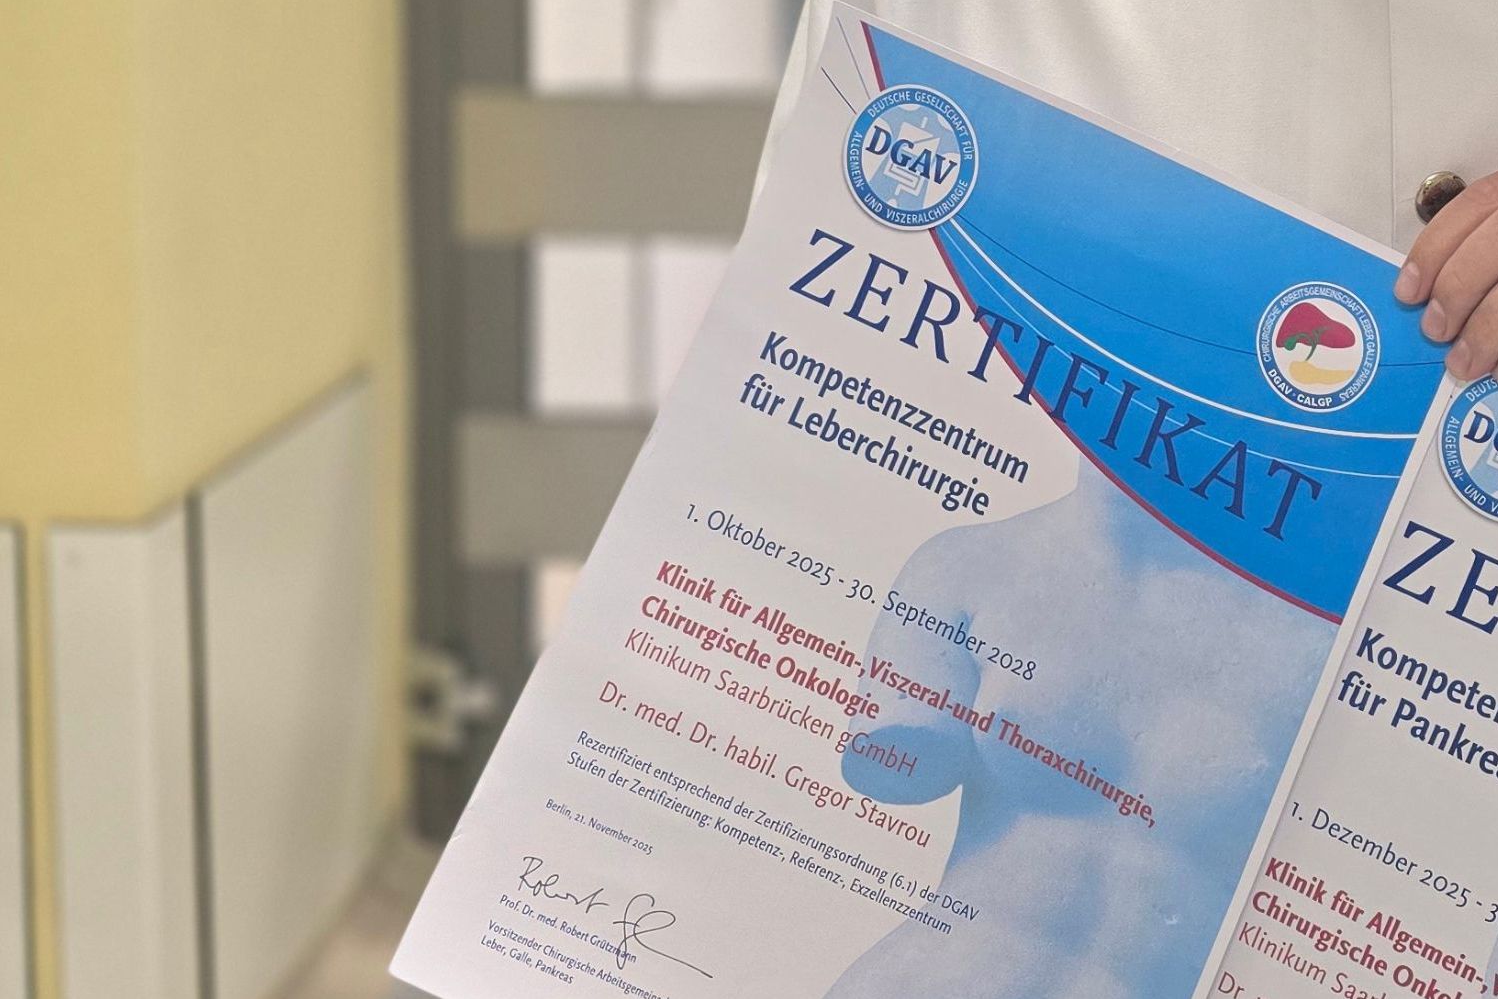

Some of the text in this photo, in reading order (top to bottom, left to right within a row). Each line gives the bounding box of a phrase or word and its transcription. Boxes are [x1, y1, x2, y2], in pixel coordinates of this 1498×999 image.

[865, 125, 958, 185] DGAV
[868, 90, 975, 161] DEUTSCHE GESELLSCHAFT FÜR
[864, 193, 883, 214] UND
[886, 179, 969, 225] VISZERALCHIRURGIE
[760, 331, 1028, 483] Kompetenzzentrum
[790, 229, 1322, 541] ZERTIFIKAT
[1268, 369, 1333, 407] DGAV CALGP
[740, 374, 989, 515] für Leberchirurgie
[1464, 484, 1487, 506] UND
[687, 504, 698, 522] 1.
[708, 511, 785, 558] Oktober
[787, 551, 834, 585] 2025
[846, 579, 875, 604] 30.
[883, 591, 986, 653] September
[987, 647, 1036, 680] 2028
[642, 596, 879, 719] Chirurgische Onkologie
[657, 561, 716, 603] Klinik
[719, 589, 752, 618] für
[999, 719, 1155, 828] Thoraxchirurgie,
[1338, 671, 1387, 716] für
[625, 629, 917, 777] Klinikum Saarbrücken gGmbH
[599, 681, 930, 847] Dr. med. Dr. habil. Gregor Stavrou
[546, 799, 653, 855] Berlin, 21. November 2025
[567, 752, 951, 934] Stufen der Zertifizierung: Kompetenz-, Referenz-, Exzellenzzentrum
[577, 731, 979, 921] Rezertifiziert entsprechend der Zertifizierungsordnung (6.1) der DGAV
[1292, 802, 1302, 820] 1.
[1312, 808, 1417, 875] Dezember
[1419, 870, 1471, 907] 2025
[500, 895, 521, 910] Prof.
[522, 904, 534, 918] Dr.
[537, 914, 558, 928] med.
[560, 921, 589, 941] Robert
[1265, 857, 1327, 904] Klinik
[1331, 890, 1364, 922] für
[481, 935, 573, 984] Leber, Galle, Pankreas
[489, 920, 542, 951] Vorsitzender
[543, 945, 596, 975] Chirurgische
[1239, 922, 1326, 984] Klinikum
[1253, 892, 1387, 976] Chirurgische
